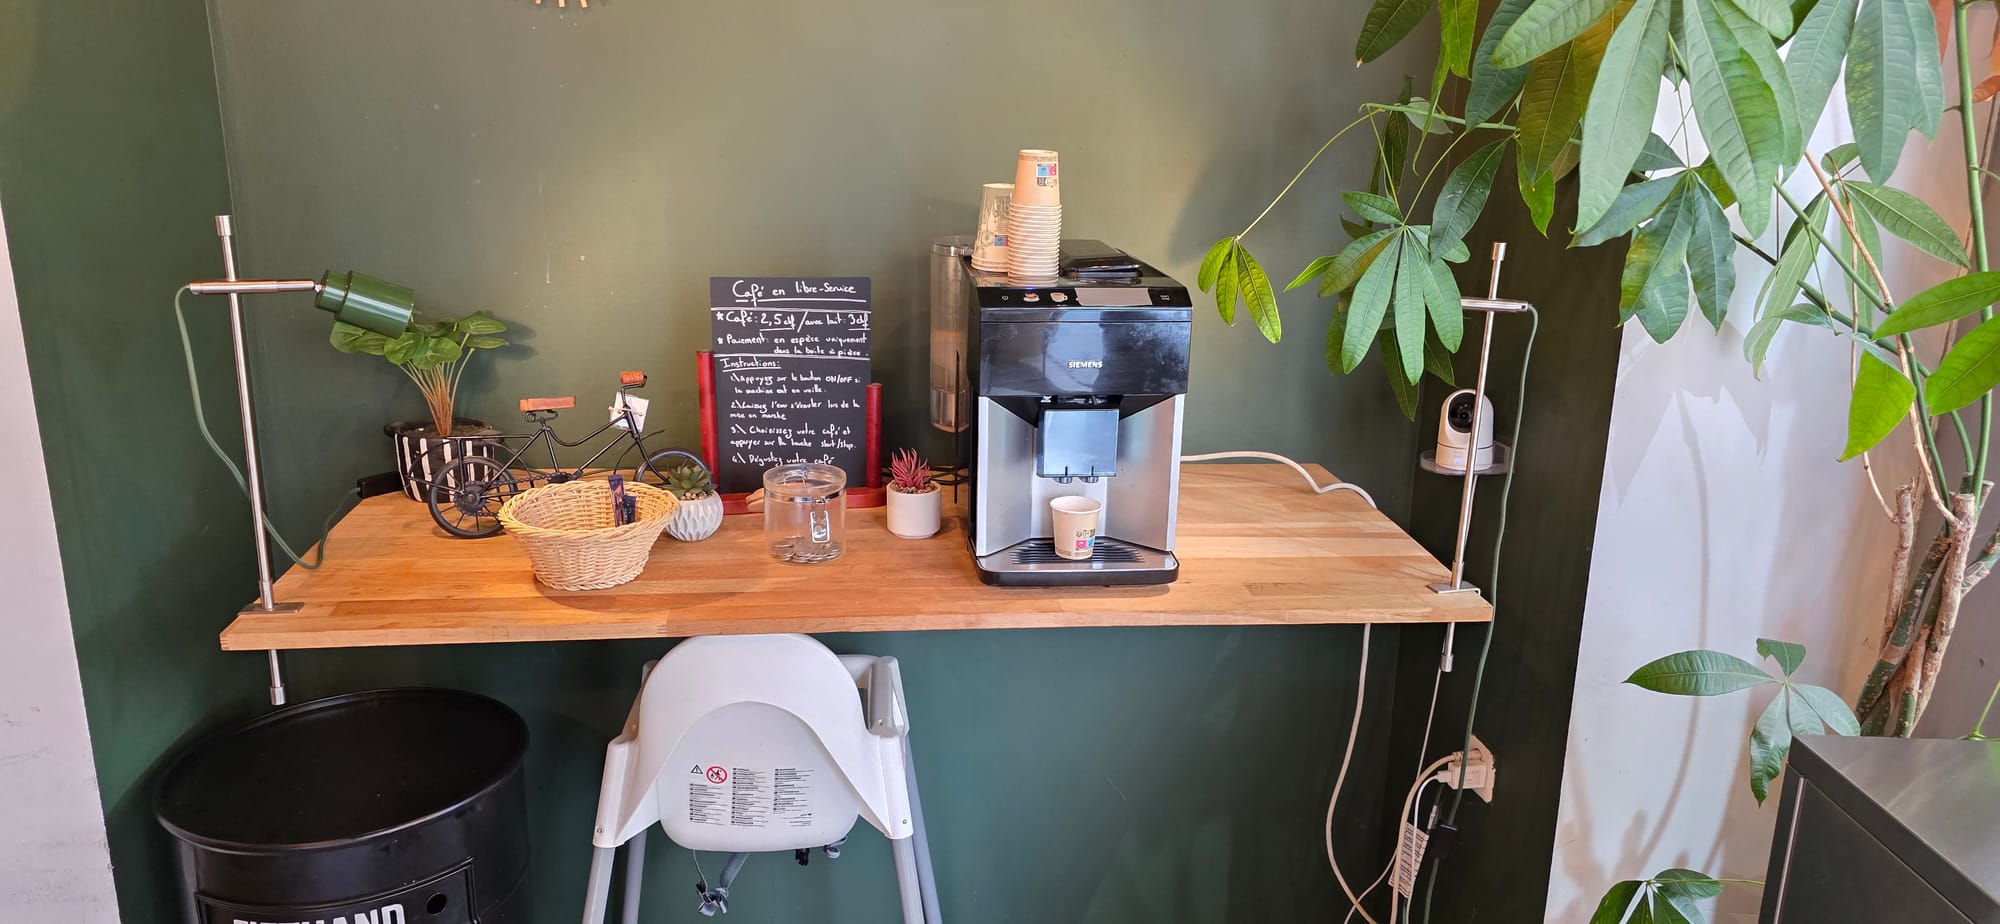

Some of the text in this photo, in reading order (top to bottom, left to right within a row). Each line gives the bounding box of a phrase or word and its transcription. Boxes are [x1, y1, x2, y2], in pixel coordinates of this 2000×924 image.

[732, 280, 765, 307] Café
[772, 287, 786, 296] en
[790, 333, 820, 347] espèce
[825, 332, 868, 347] uniquement
[773, 345, 790, 354] dans
[794, 345, 803, 354] la
[1068, 360, 1104, 369] SIEMENS
[791, 372, 798, 381] le
[799, 369, 822, 382] bouton
[825, 374, 853, 384] ON/OFF
[734, 386, 743, 394] la
[745, 385, 774, 394] machine
[776, 383, 788, 394] est
[827, 399, 839, 409] lors
[840, 399, 849, 409] de
[852, 398, 861, 408] la
[761, 410, 787, 420] marche
[749, 425, 793, 440] Choisissez
[796, 421, 816, 435] votre
[822, 425, 841, 439] café
[842, 425, 851, 435] et
[729, 439, 761, 450] appuyer
[777, 435, 788, 446] la
[790, 437, 812, 447] touche
[748, 451, 783, 467] Dégustez
[786, 452, 808, 464] votre
[813, 453, 836, 465] café
